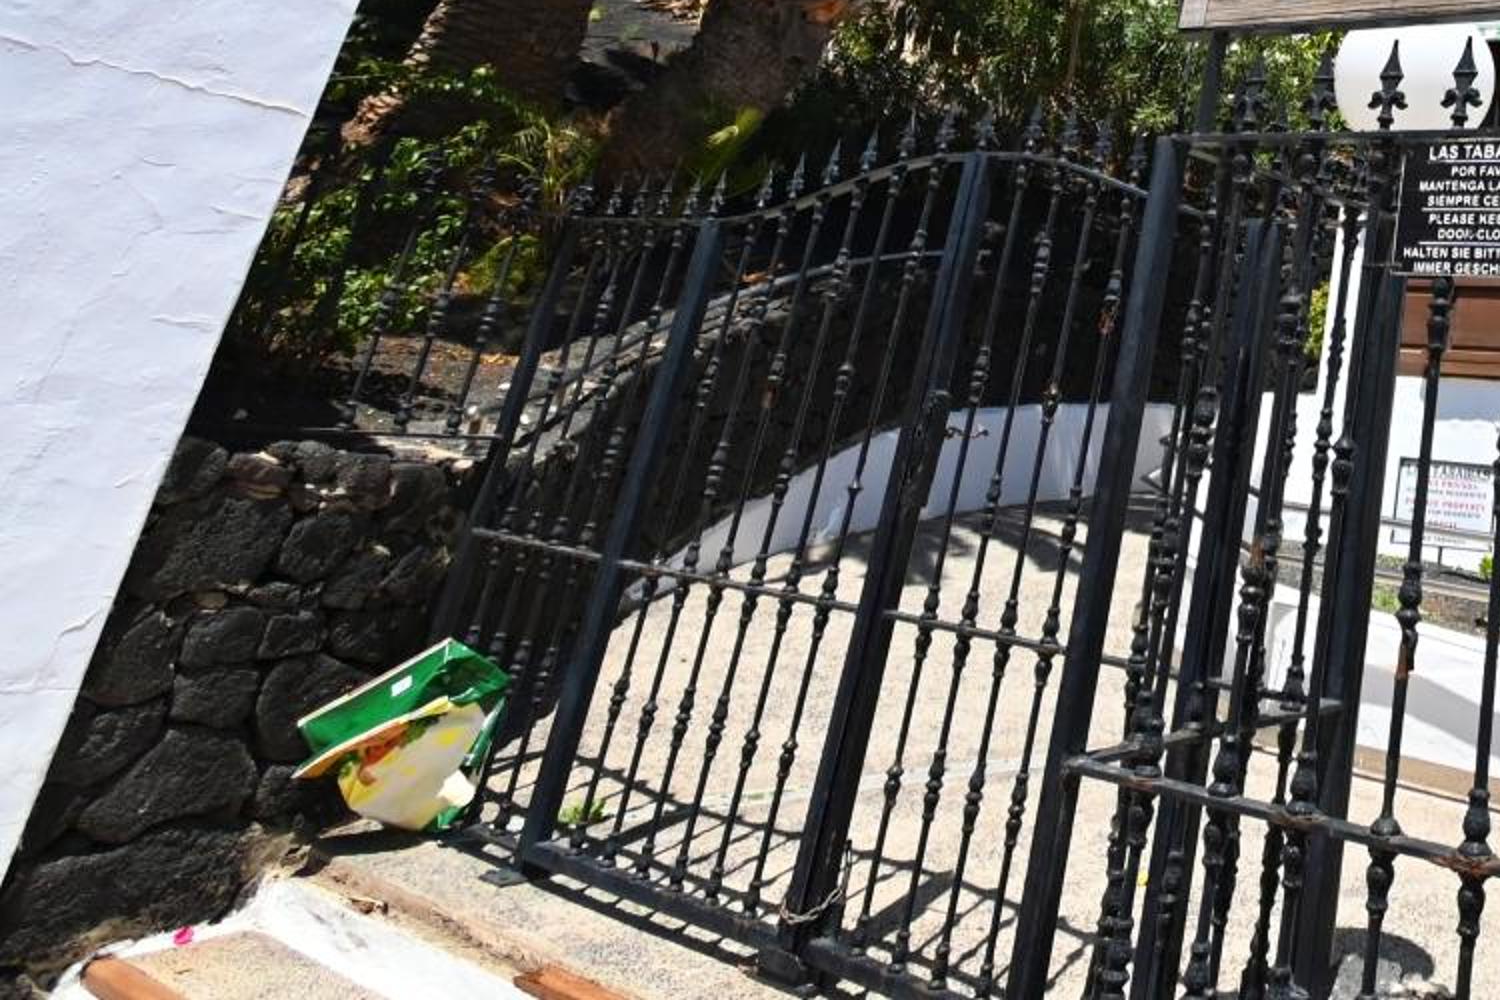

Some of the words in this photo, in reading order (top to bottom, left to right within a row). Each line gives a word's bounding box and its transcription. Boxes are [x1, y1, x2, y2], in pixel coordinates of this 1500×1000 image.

[1429, 145, 1458, 161] LAS
[1451, 165, 1476, 177] POR
[1419, 180, 1485, 191] MANTENGA
[1427, 195, 1480, 207] SIEMPRE
[1428, 213, 1475, 225] PLEASE
[1403, 247, 1448, 259] HALTEN
[1451, 247, 1470, 259] SIE
[1413, 262, 1451, 274] IMMER
